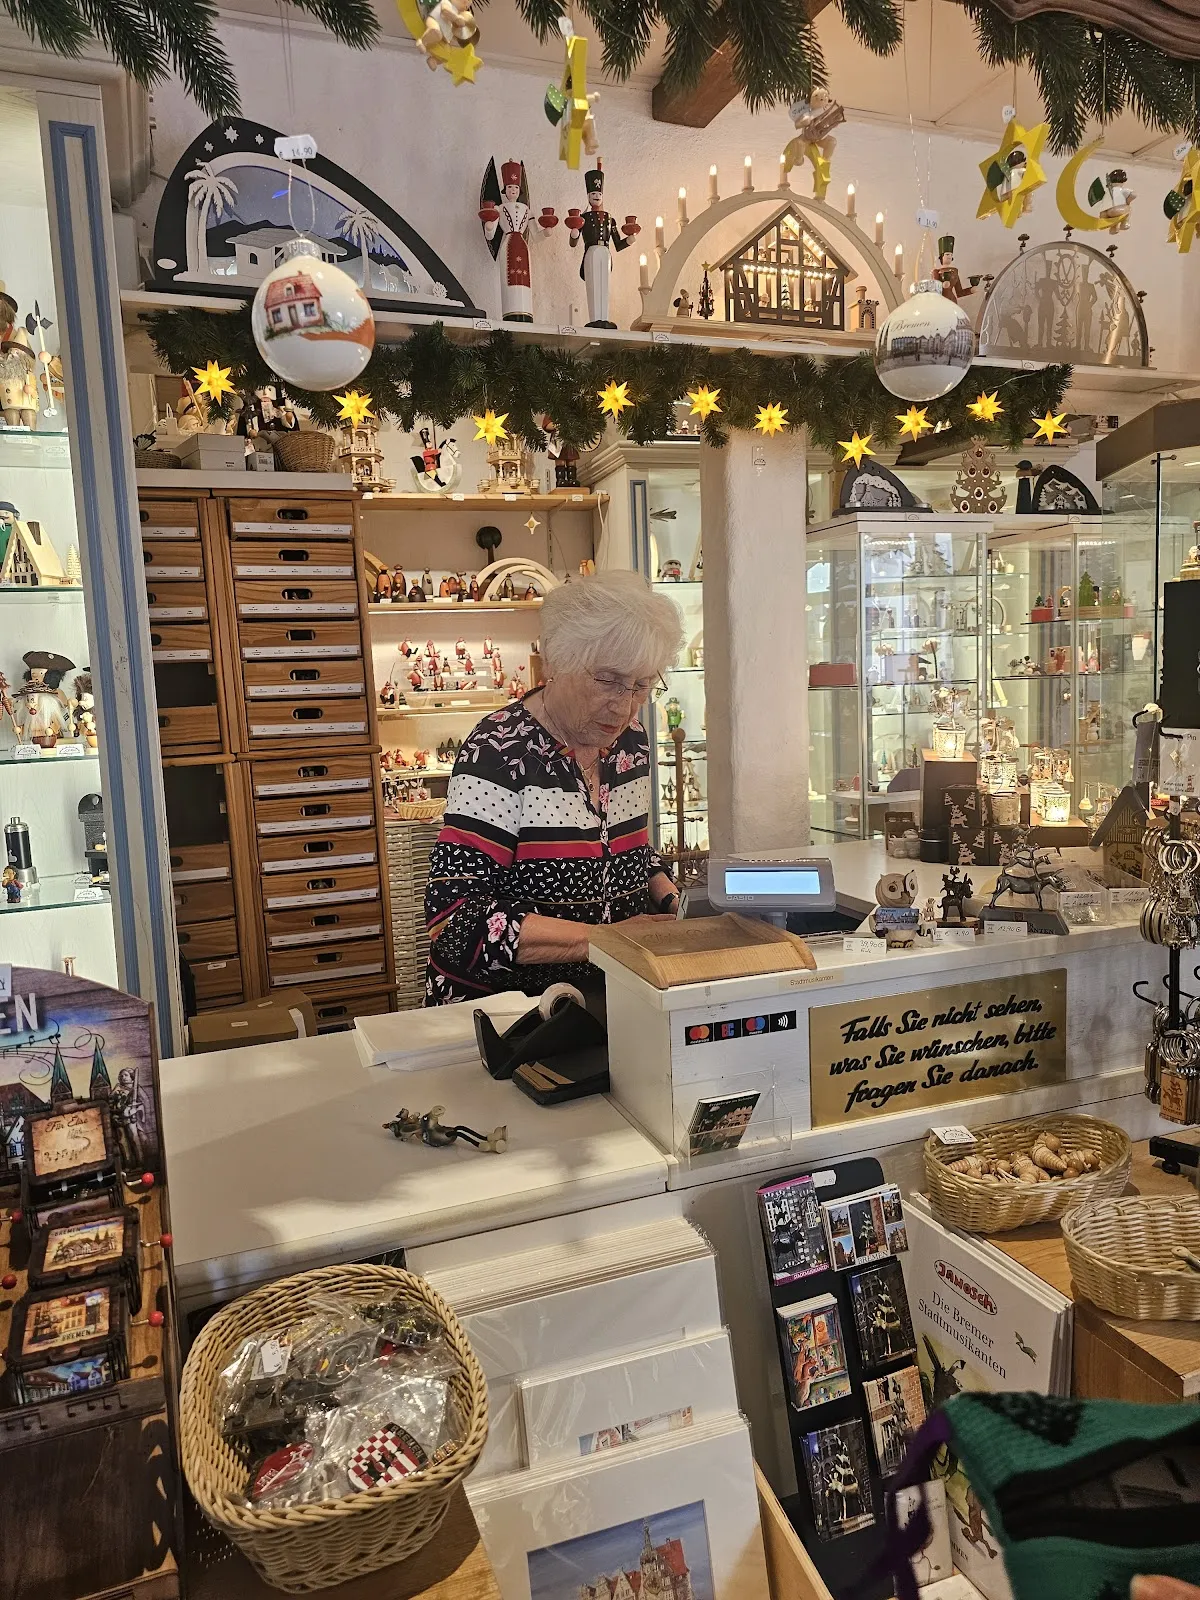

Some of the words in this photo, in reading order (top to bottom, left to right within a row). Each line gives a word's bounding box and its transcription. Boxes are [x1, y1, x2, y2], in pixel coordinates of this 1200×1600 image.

[890, 319, 931, 332] Bremen
[790, 974, 835, 987] Stadtmusikanten
[839, 1015, 893, 1045] Falls
[895, 1009, 929, 1035] Sie
[931, 1001, 983, 1029] nicht
[983, 994, 1043, 1020] sehen,
[829, 1055, 872, 1076] was
[874, 1044, 906, 1070] Sie
[909, 1030, 1009, 1063] wünschen,
[1013, 1021, 1057, 1045] bitte
[843, 1079, 917, 1114] fragen
[920, 1064, 954, 1090] Sie
[959, 1049, 1040, 1084] danach.
[67, 1114, 89, 1128] Elise
[54, 1226, 81, 1237] BREMEN
[857, 1249, 890, 1265] BREMEN
[931, 1290, 951, 1315] Die
[952, 1306, 995, 1349] Bremer
[60, 1329, 92, 1342] BREMEN
[918, 1297, 1007, 1380] Stadtmusikanten
